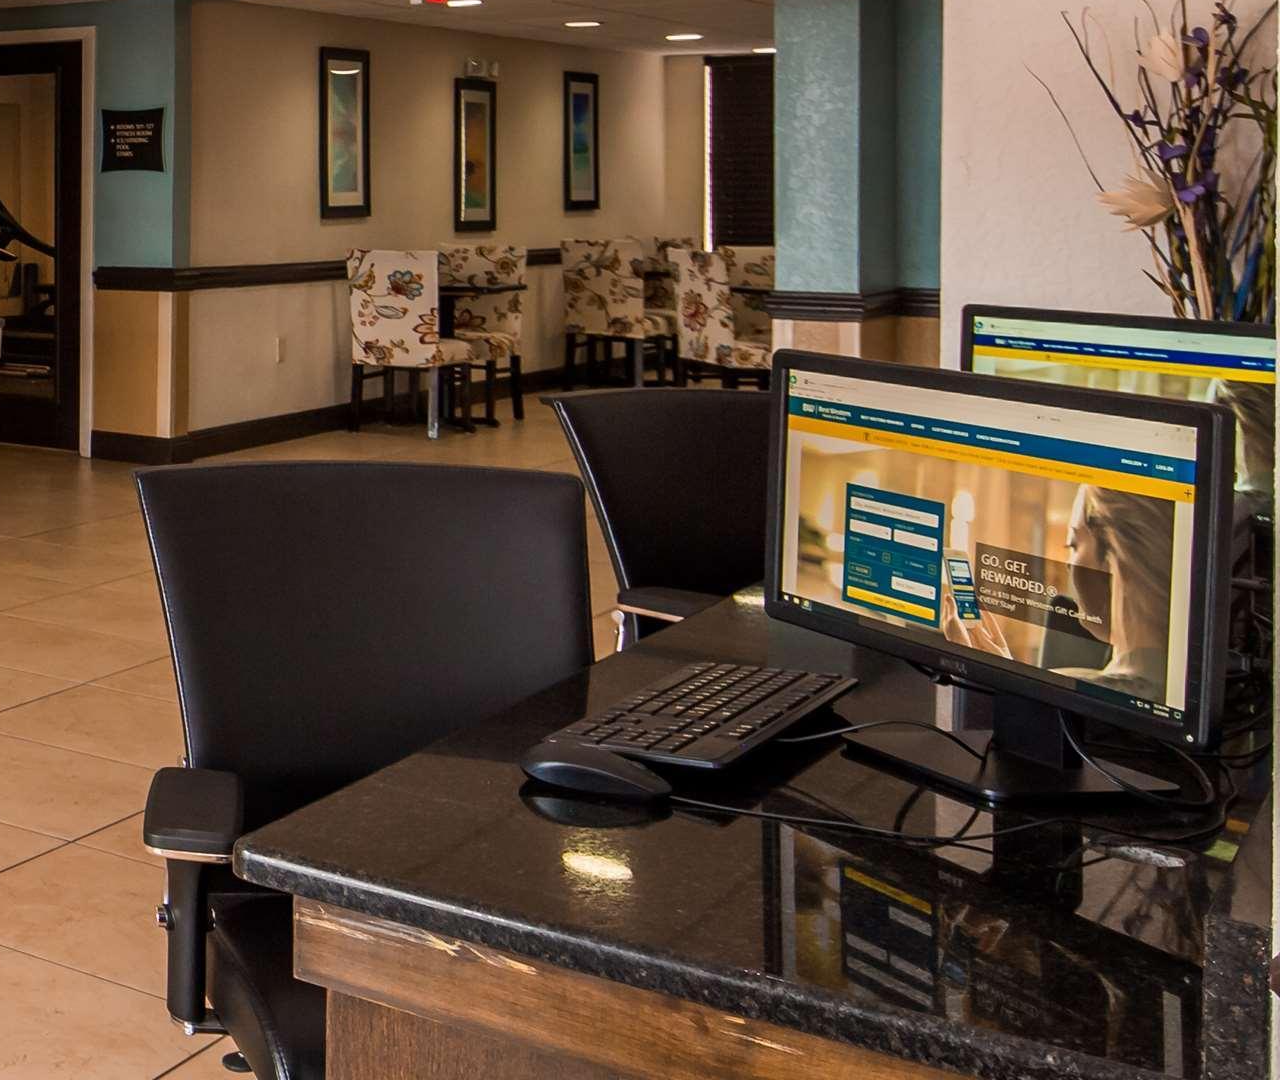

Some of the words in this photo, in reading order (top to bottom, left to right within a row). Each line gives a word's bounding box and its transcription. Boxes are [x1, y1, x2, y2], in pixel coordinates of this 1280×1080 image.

[981, 553, 1002, 568] GO.
[1004, 559, 1030, 575] GET.
[979, 586, 991, 596] Get
[1011, 593, 1025, 604] Best
[1026, 598, 1054, 612] Western
[1055, 605, 1068, 616] Gift
[1068, 609, 1085, 620] Card
[1086, 613, 1103, 624] with
